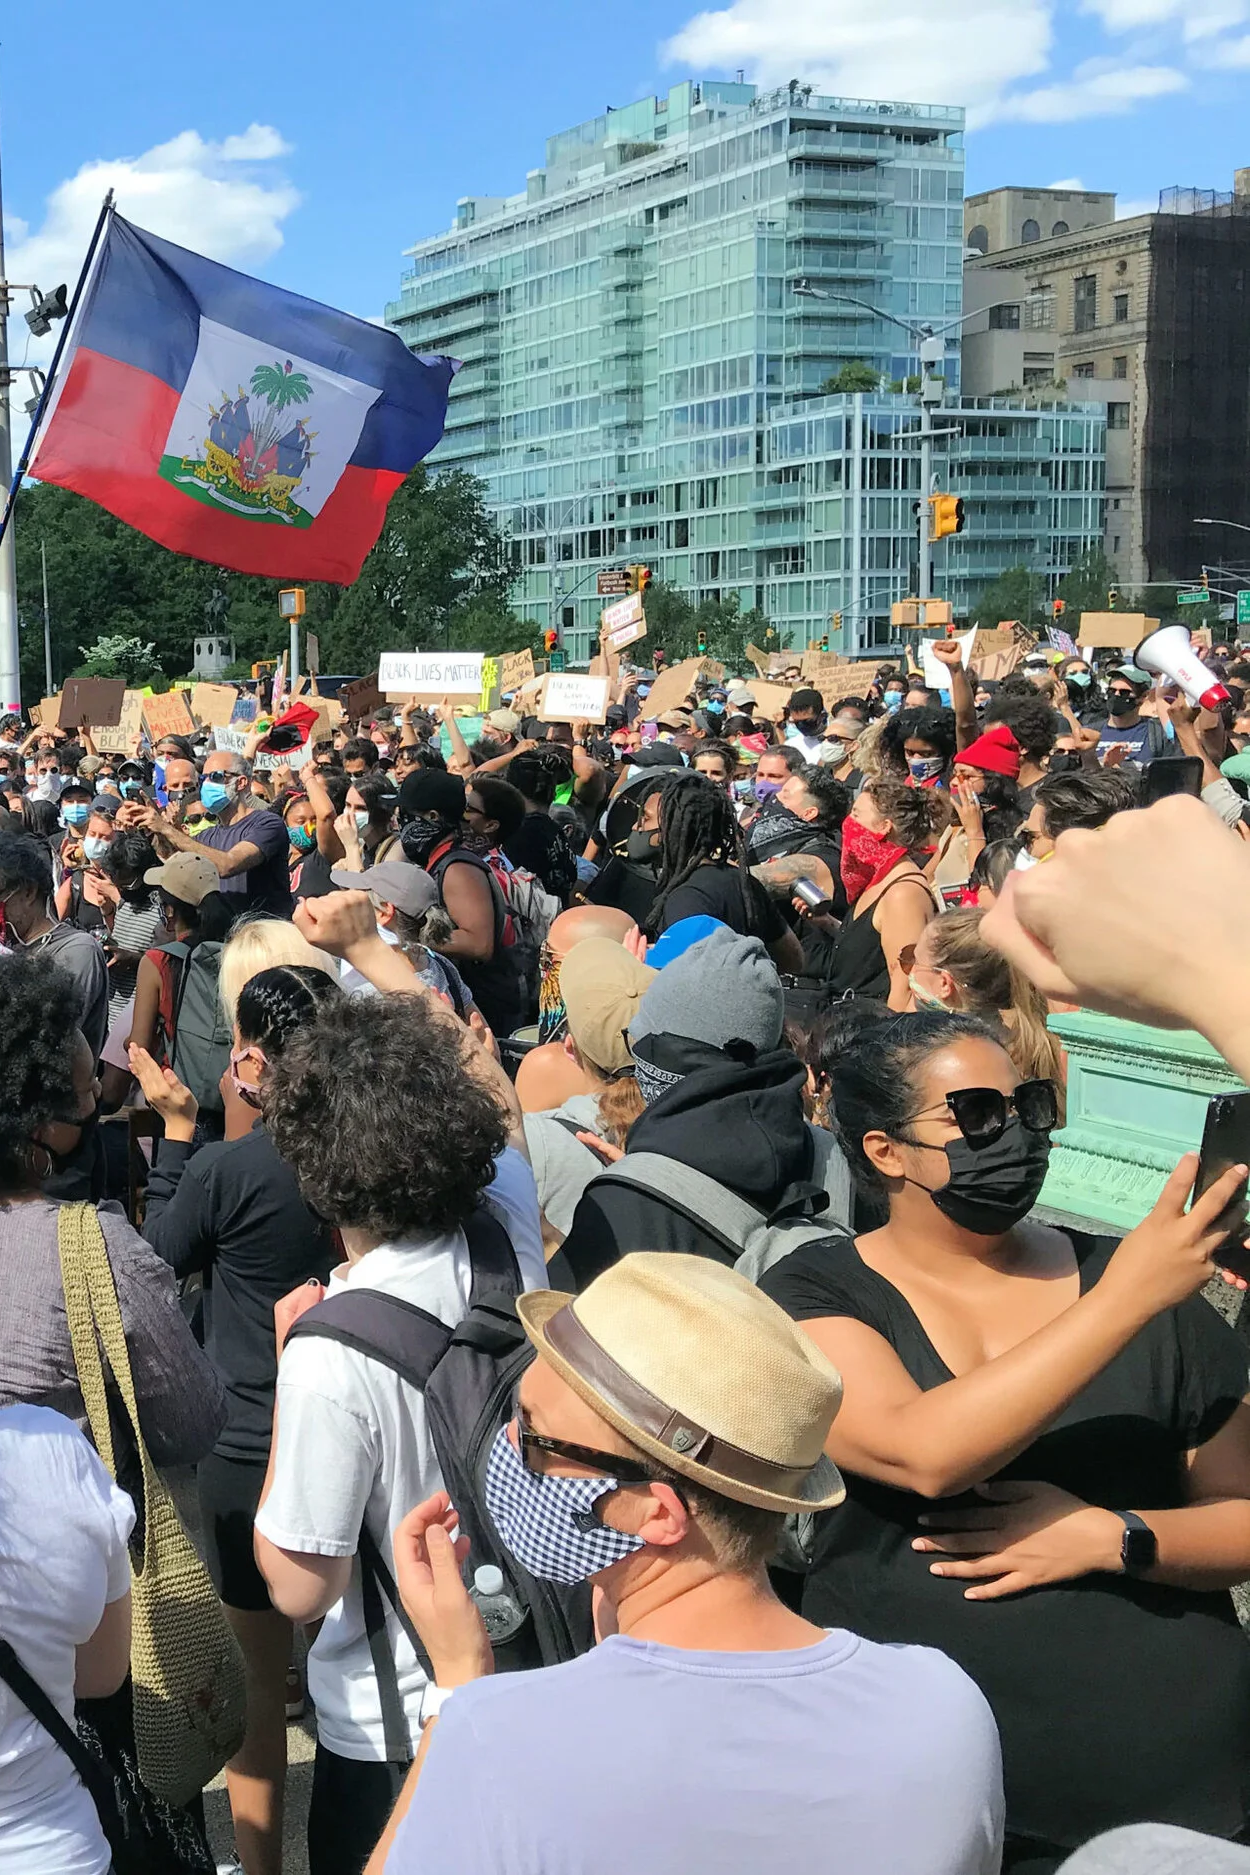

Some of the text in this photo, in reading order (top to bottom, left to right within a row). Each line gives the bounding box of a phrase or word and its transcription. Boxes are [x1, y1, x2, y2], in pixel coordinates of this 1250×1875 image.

[414, 663, 442, 681] LIVES
[444, 664, 482, 682] MATTER
[99, 734, 128, 748] BLM
